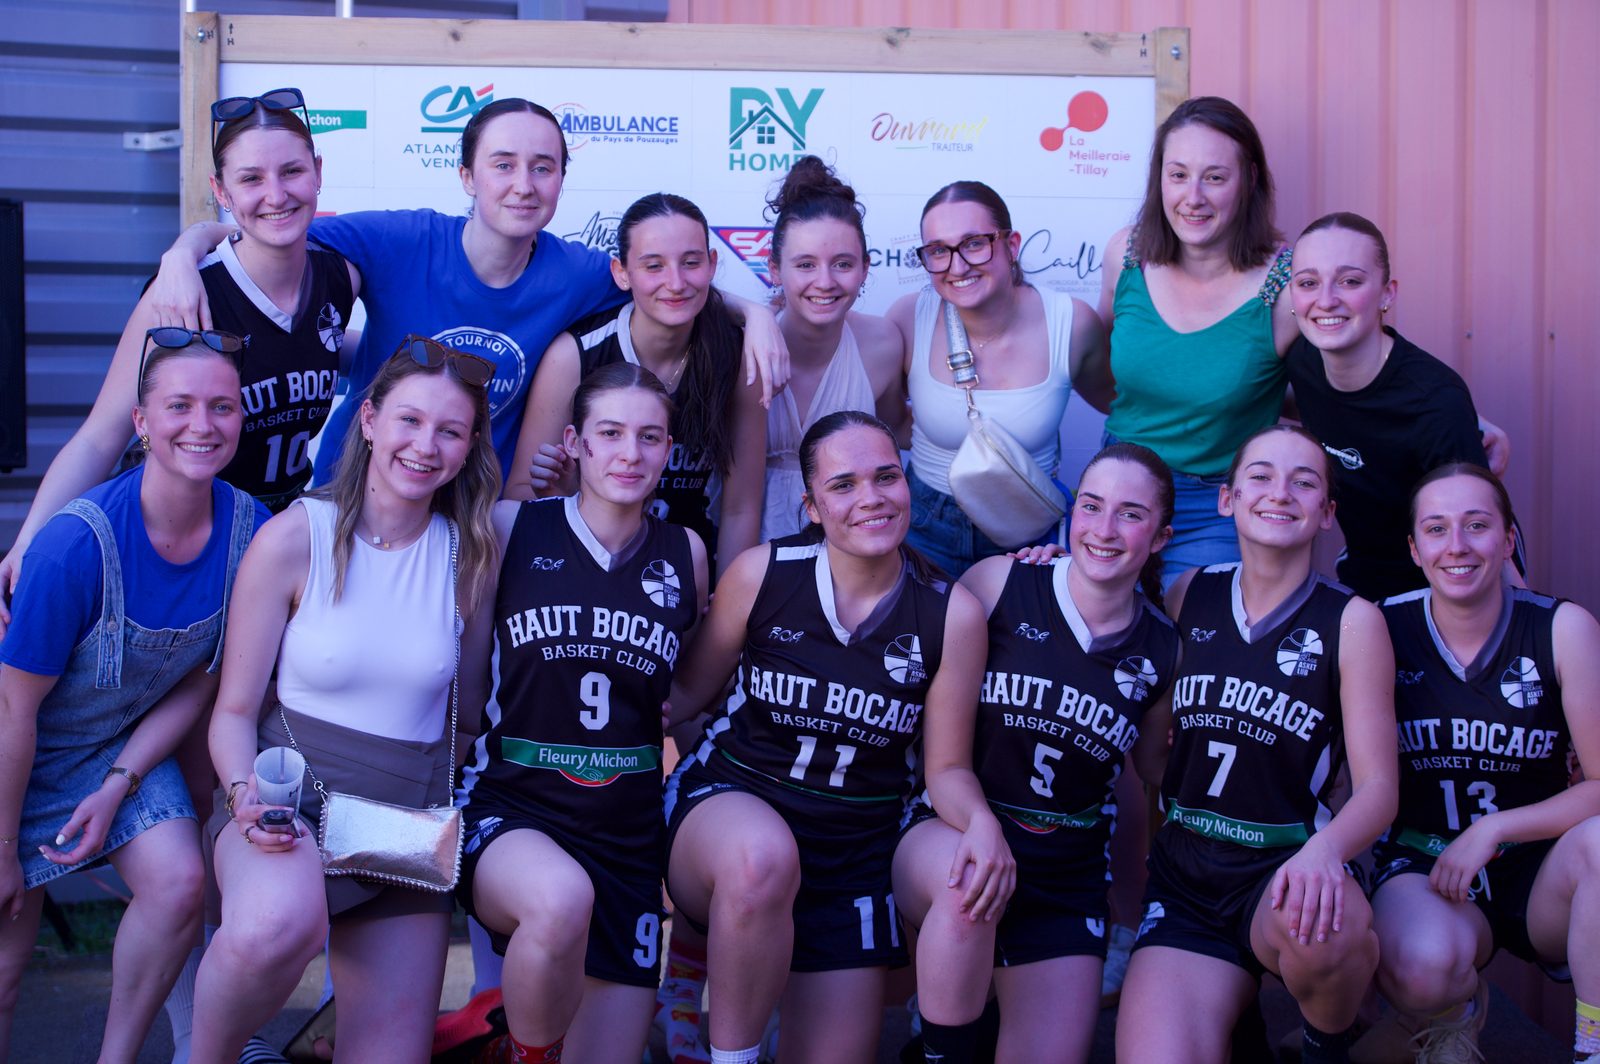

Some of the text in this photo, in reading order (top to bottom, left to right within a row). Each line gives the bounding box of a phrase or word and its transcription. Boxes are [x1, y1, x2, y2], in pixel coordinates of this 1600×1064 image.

[561, 113, 678, 133] AMBULANCE
[604, 135, 621, 144] Pays
[1069, 136, 1085, 146] La
[421, 158, 463, 168] VEN
[931, 142, 973, 152] TRAITEUR
[1069, 150, 1131, 161] Meilleraie
[1019, 229, 1103, 279] Caill
[446, 335, 508, 356] TOURNOI
[286, 369, 339, 404] BOCA
[245, 409, 304, 433] BASKET
[264, 430, 311, 483] 10
[506, 605, 582, 648] HAUT
[541, 644, 657, 676] BASKET CLUB
[579, 671, 612, 730] 9
[750, 665, 923, 734] HAUT BOCAGE
[980, 671, 1052, 710] HAUT
[1172, 674, 1216, 715] AUT
[1219, 676, 1325, 742] BOCAGE
[770, 711, 890, 748] BASKET CLUB
[1003, 713, 1111, 762] BASKET CLUB
[1180, 713, 1277, 746] BASKET CLUB
[1397, 718, 1559, 759] AUT BOCAGE
[539, 748, 638, 770] Fleury Michon
[789, 735, 857, 787] 11
[1030, 742, 1064, 798] 5
[1207, 740, 1237, 798] 7
[1411, 756, 1521, 773] BASKET CLUB
[1439, 779, 1499, 831] 13
[1172, 809, 1265, 843] Fleury Michon
[632, 912, 660, 969] 9
